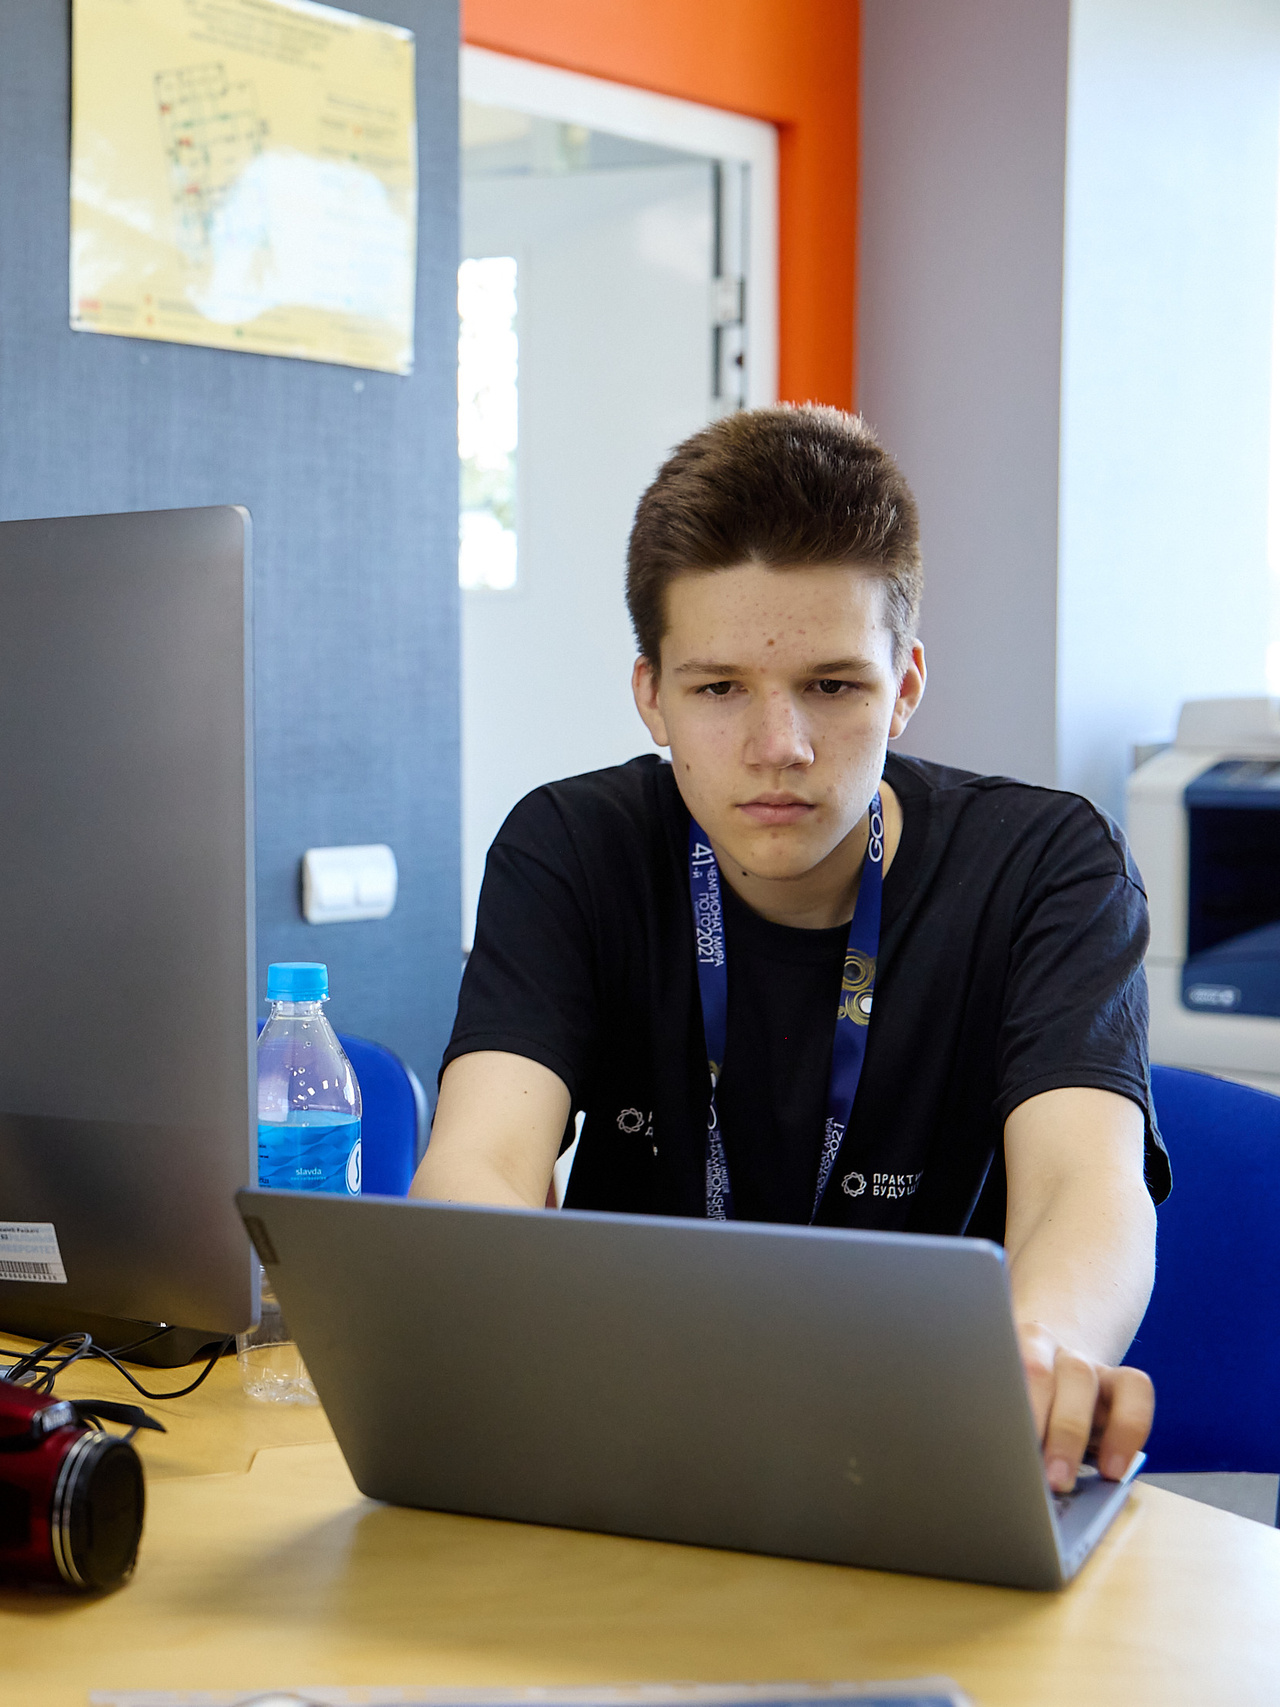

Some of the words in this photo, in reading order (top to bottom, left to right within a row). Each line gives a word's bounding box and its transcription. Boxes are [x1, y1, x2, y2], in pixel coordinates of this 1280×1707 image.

[699, 892, 710, 911] ПО
[707, 865, 722, 932] ЧЕМПИОНАТ
[696, 927, 715, 963] 2021
[712, 935, 725, 968] МИРА
[827, 1122, 845, 1160] 2021
